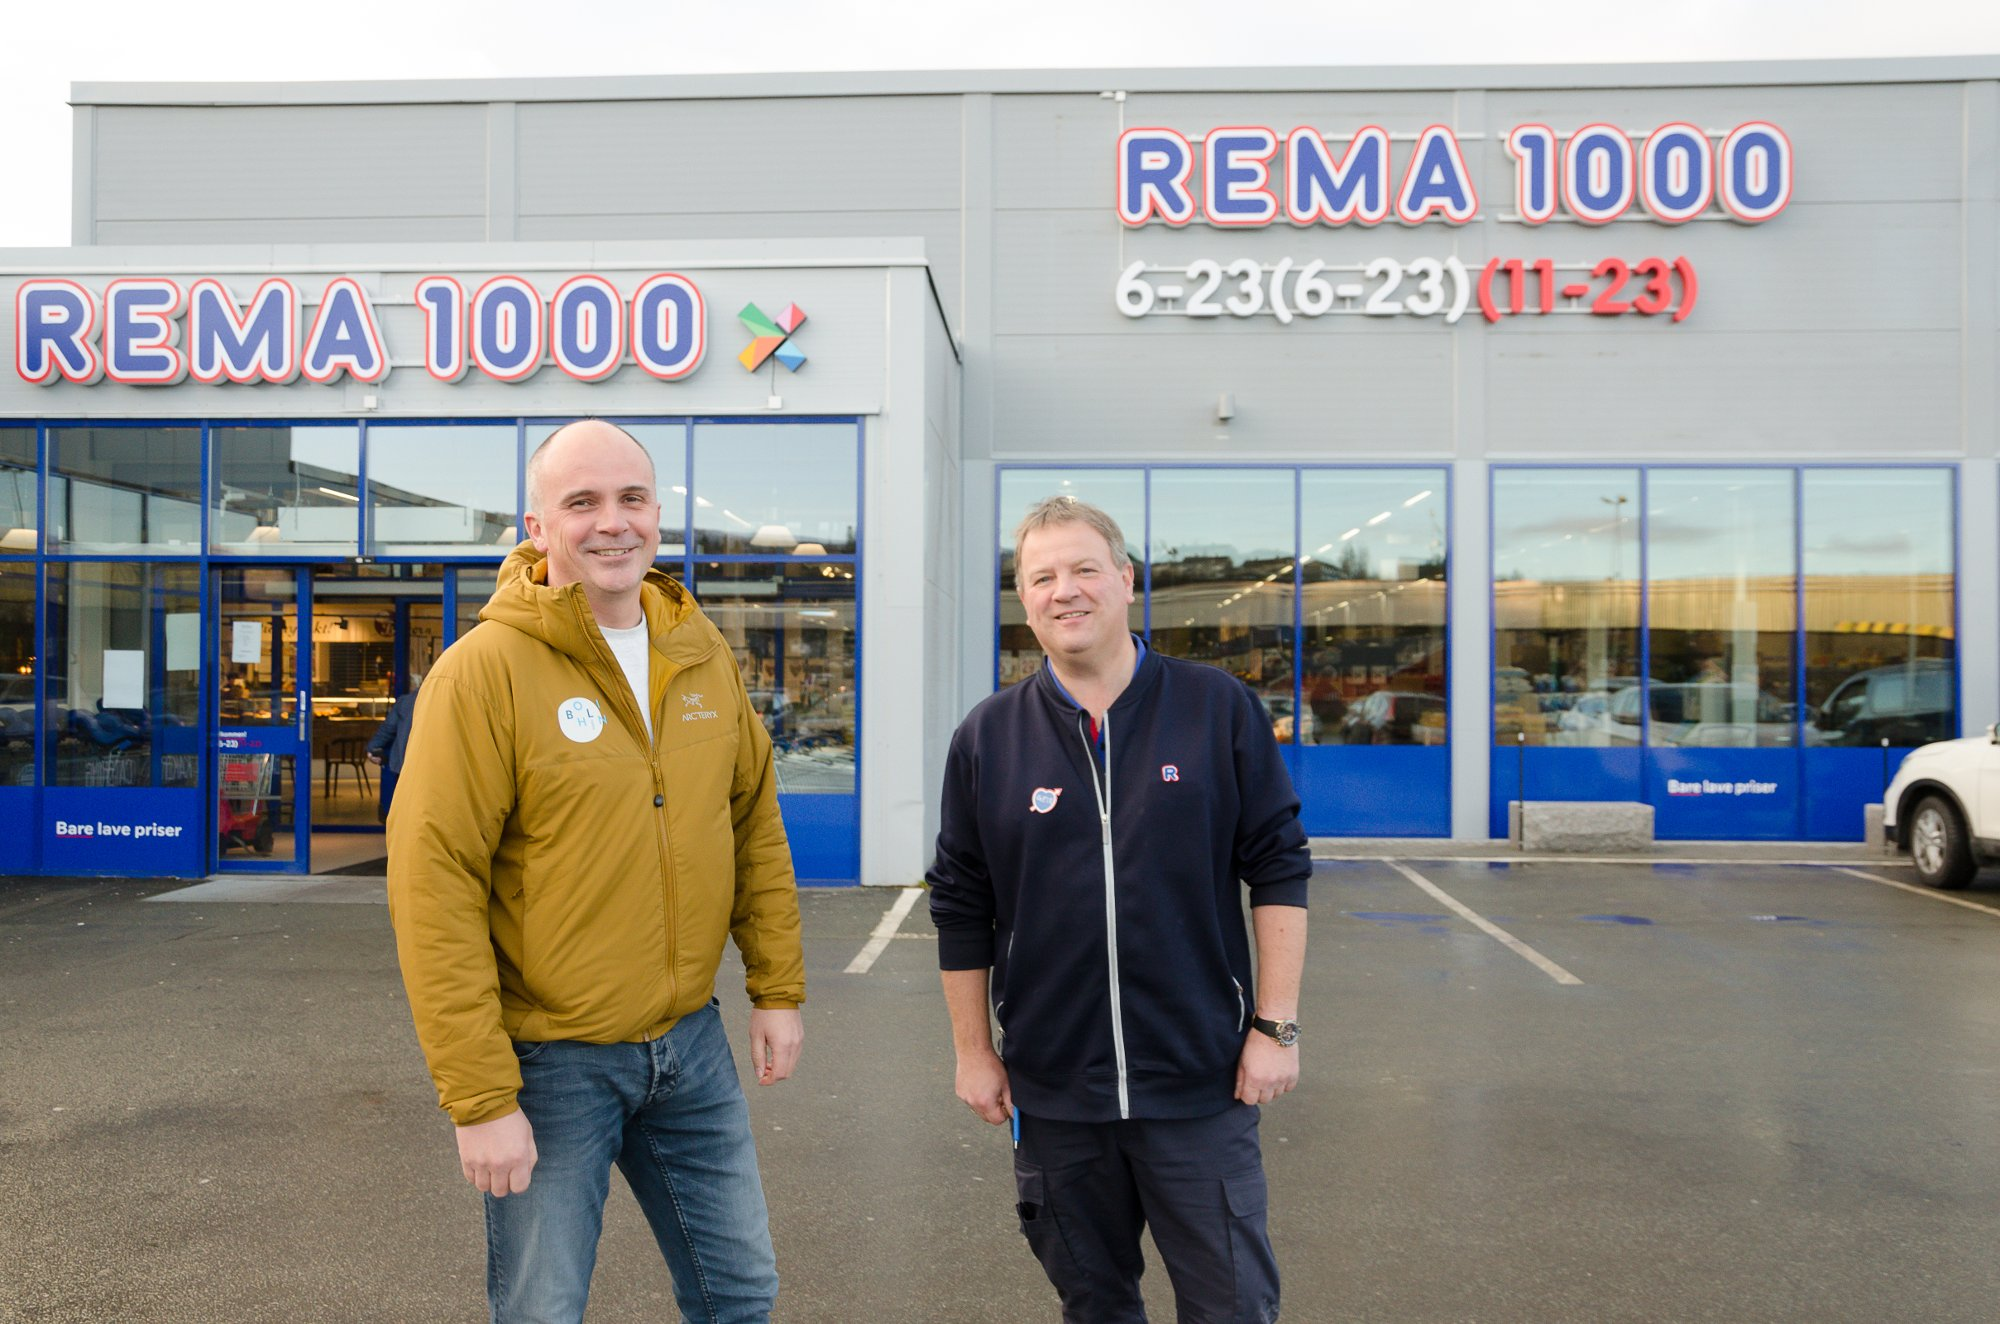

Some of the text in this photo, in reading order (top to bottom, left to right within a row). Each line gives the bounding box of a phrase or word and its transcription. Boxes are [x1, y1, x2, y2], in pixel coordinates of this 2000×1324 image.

[1116, 121, 1795, 228] REMA 1000
[15, 272, 707, 385] REMA 1000
[1161, 764, 1180, 782] R
[1667, 779, 1778, 796] Bare lave priser
[56, 820, 183, 839] Bare lave priser
